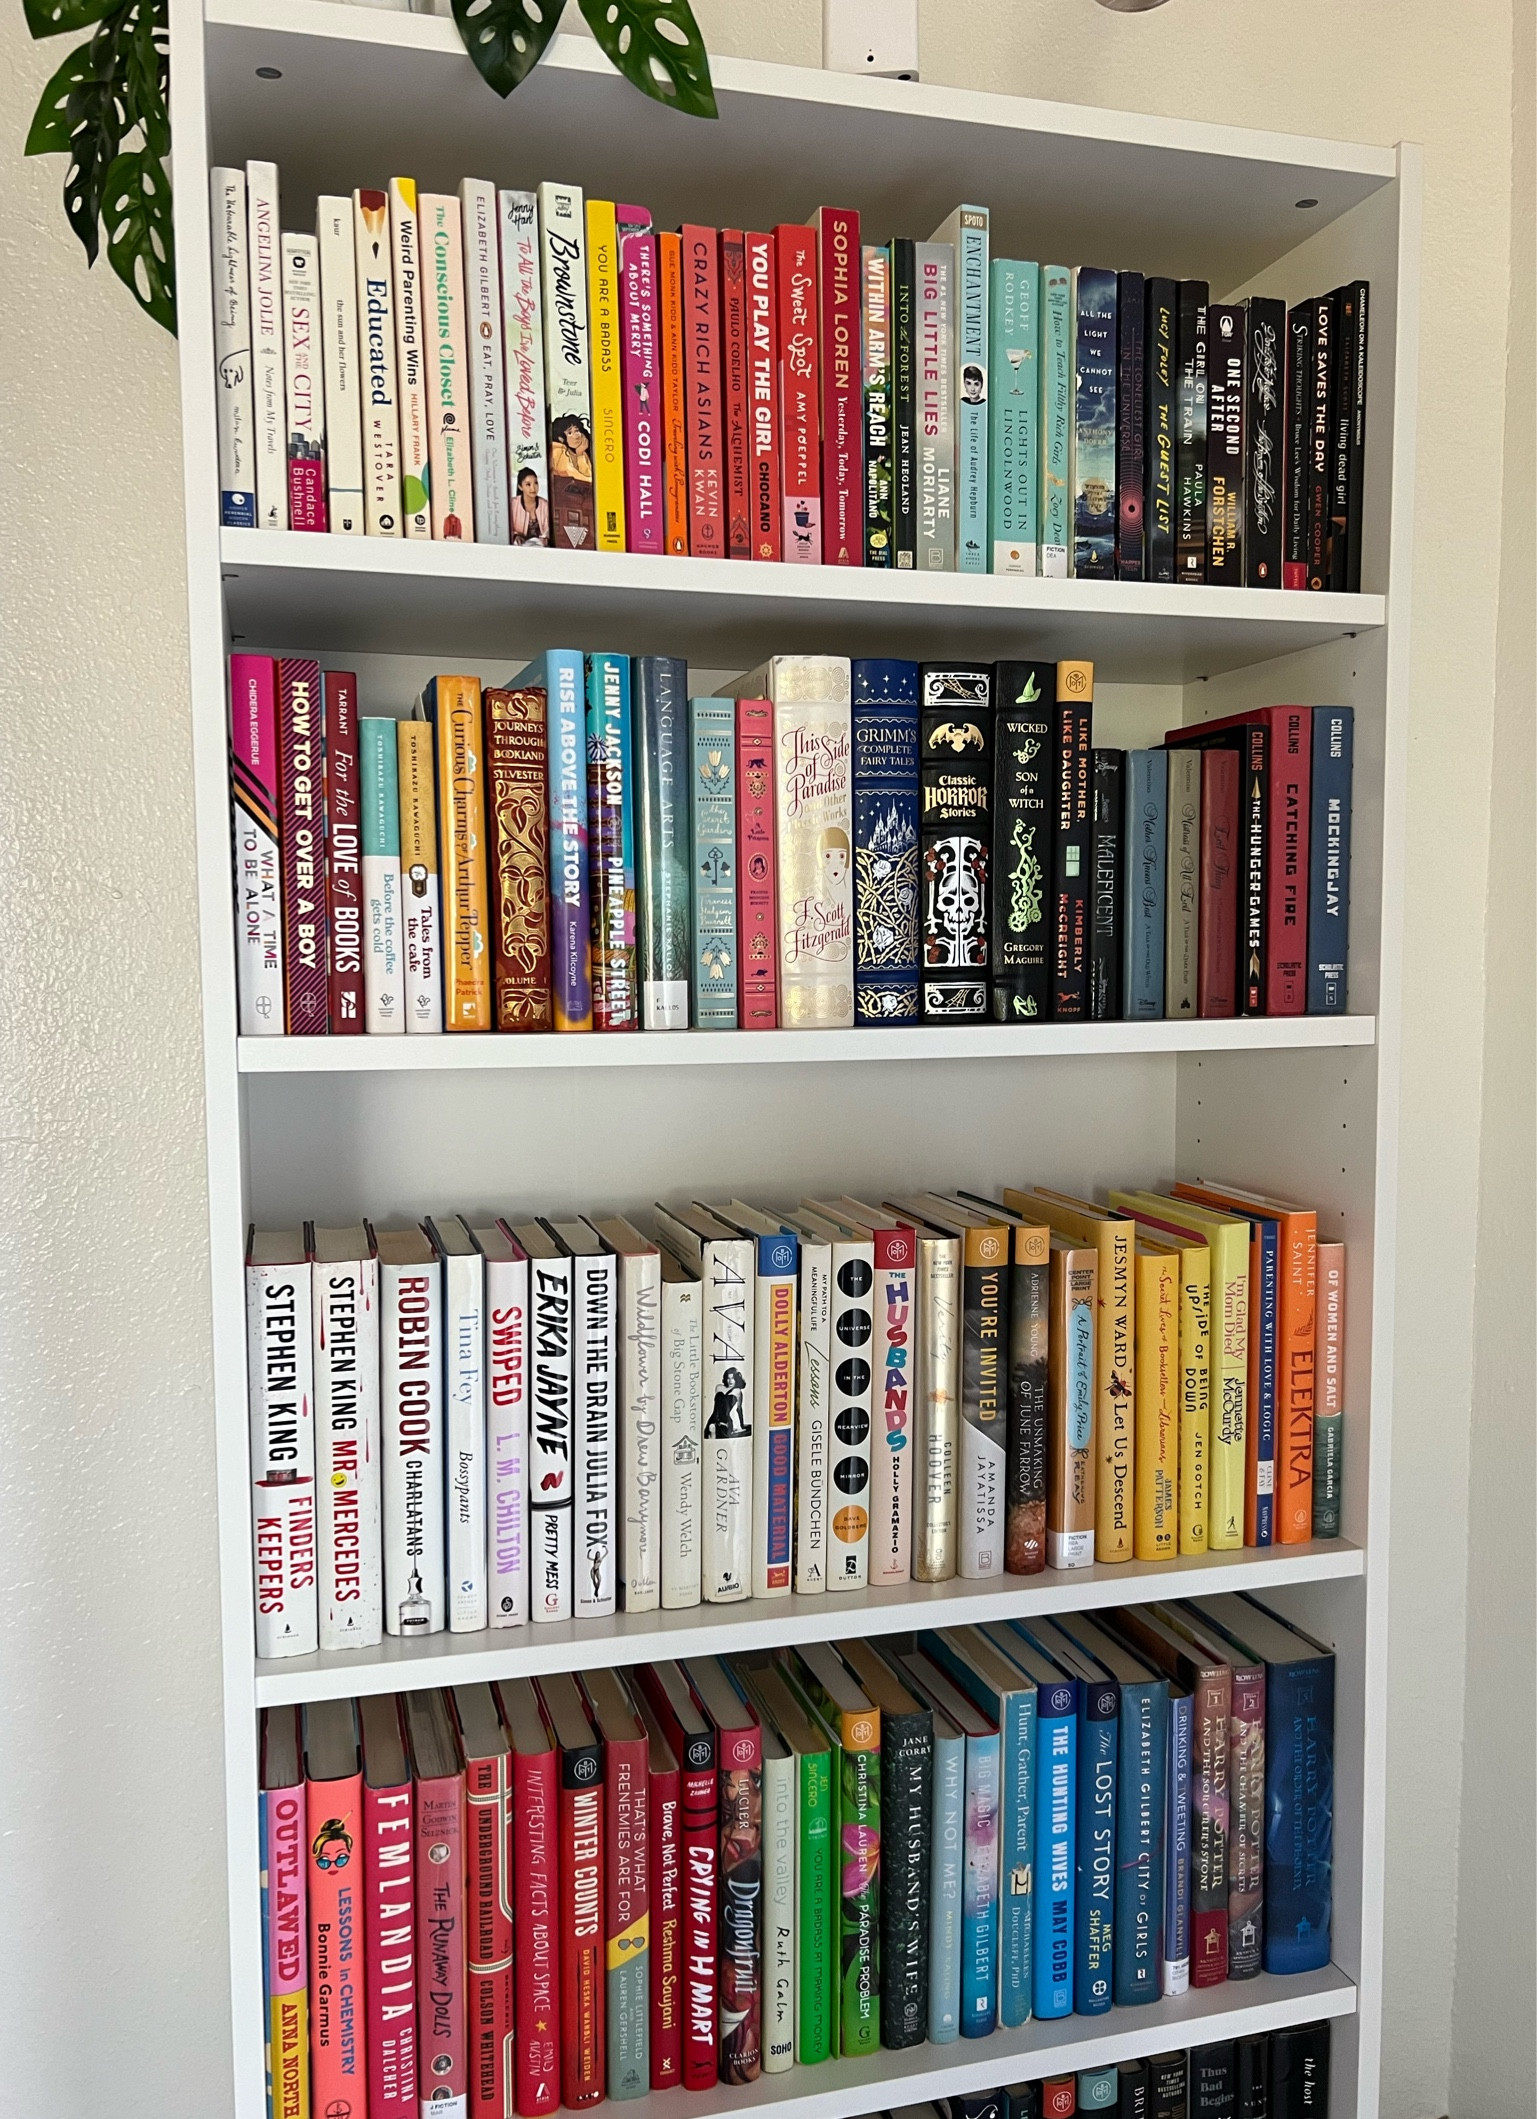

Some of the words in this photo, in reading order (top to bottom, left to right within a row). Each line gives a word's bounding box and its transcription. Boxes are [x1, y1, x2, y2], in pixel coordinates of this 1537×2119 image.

[257, 199, 272, 282] ANGELINA
[400, 221, 413, 264] Weird
[436, 206, 446, 227] The
[476, 196, 488, 262] ELIZABETH
[435, 232, 452, 338] Conscious
[693, 242, 708, 315] CRAZY
[833, 221, 848, 305] SOPHIA
[259, 287, 273, 335] JOLIE
[336, 300, 344, 311] the
[401, 270, 415, 344] Parenting
[480, 267, 491, 317] GILBERT
[547, 229, 585, 365] Brownstone
[966, 235, 981, 356] ENCHANTMENT
[1005, 272, 1015, 336] RODKEY
[1020, 280, 1029, 331] GEOFF
[337, 330, 346, 344] and
[338, 347, 346, 359] her
[367, 278, 391, 406] Educated
[696, 323, 710, 374] RICH
[835, 314, 849, 388] LOREN
[339, 362, 348, 391] flowers
[407, 349, 419, 385] Wins
[439, 344, 455, 408] Closet
[410, 394, 419, 431] HILLARY
[603, 408, 615, 463] SINCERO
[698, 382, 712, 460] ASIANS
[1159, 404, 1168, 429] THE
[373, 421, 384, 502] WESTOVER
[385, 442, 394, 481] TARA
[413, 436, 421, 466] FRANK
[638, 421, 651, 465] CODI
[1157, 434, 1170, 495] GUEST
[293, 468, 305, 525] Bushnell
[304, 469, 317, 525] Candace
[639, 475, 653, 519] HALL
[759, 462, 770, 532] CHOCANO
[922, 447, 936, 539] MORIARTY
[937, 468, 950, 518] LIANE
[1182, 477, 1192, 540] HAWKINS
[1194, 464, 1203, 506] PAULA
[1157, 499, 1170, 534] LIST
[1212, 477, 1224, 566] FORSTCHEN
[248, 679, 258, 720] CHIDERA
[604, 662, 621, 718] JENNY
[250, 721, 259, 765] EGGERUE
[493, 721, 544, 734] JOURNEYS
[494, 737, 544, 745] THROUGH
[659, 673, 674, 786] LANGUAGE
[857, 744, 913, 755] COMPLETE
[1007, 723, 1048, 734] WICKED
[1251, 732, 1264, 771] COLLINS
[1287, 715, 1300, 754] COLLINS
[1330, 719, 1343, 757] COLLINS
[494, 749, 544, 761] BOOKLAND
[495, 769, 544, 780] SILVESTER
[605, 724, 623, 805] JACKSON
[861, 757, 886, 766] FAIRY
[890, 757, 914, 766] TALES
[938, 775, 977, 786] Classic
[924, 786, 988, 810] HORROR
[940, 807, 977, 818] Stories
[1008, 798, 1044, 809] WITCH
[1252, 800, 1261, 818] THE
[662, 800, 675, 849] ARTS
[1285, 784, 1299, 876] CATCHING
[1249, 823, 1263, 891] HUNGER
[1326, 798, 1340, 917] MOCKINGJAY
[1096, 835, 1115, 937] MALEFICENT
[1284, 885, 1296, 926] FIRE
[407, 918, 418, 939] the
[420, 906, 432, 943] Tales
[569, 921, 578, 949] Karena
[1058, 894, 1068, 978] McCREIGHT
[1074, 899, 1083, 973] KIMBERLY
[1249, 896, 1262, 948] GAMES
[408, 944, 419, 972] cafe
[422, 948, 433, 979] from
[569, 951, 579, 986] Kilcoyne
[1030, 1273, 1039, 1321] ADRIENNE
[1113, 1235, 1128, 1308] JESMYN
[398, 1277, 430, 1370] ROBIN
[535, 1269, 569, 1358] ERIKA
[774, 1288, 790, 1338] DOLLY
[980, 1273, 998, 1339] YOU'RE
[265, 1284, 296, 1391] STEPHEN
[492, 1306, 522, 1407] SWIPED
[1030, 1323, 1039, 1357] YOUNG
[1114, 1315, 1127, 1368] WARD
[774, 1342, 791, 1422] ALDERTON
[979, 1347, 997, 1421] INVITED
[267, 1403, 298, 1461] KING
[398, 1380, 430, 1457] COOK
[535, 1364, 569, 1462] JAYNE
[1218, 1378, 1234, 1445] McCurdy
[1233, 1378, 1245, 1442] Jennette
[1289, 1351, 1313, 1490] ELEKTRA
[811, 1420, 822, 1466] GISELE
[1327, 1427, 1335, 1467] GABRIELA
[456, 1451, 473, 1524] Bossypants
[586, 1449, 608, 1503] JULIA
[677, 1472, 692, 1520] Wendy
[716, 1448, 728, 1533] GARDNER
[729, 1474, 740, 1505] AVA
[976, 1455, 986, 1534] JAYATISSA
[987, 1461, 996, 1528] AMANDA
[1154, 1469, 1164, 1528] PATTERSON
[1194, 1464, 1202, 1509] GOTCH
[1326, 1469, 1334, 1499] GARCIA
[586, 1510, 608, 1548] FOX
[810, 1470, 824, 1549] BÜNDCHEN
[257, 1517, 284, 1614] KEEPERS
[289, 1497, 314, 1589] FINDERS
[680, 1523, 692, 1558] Welch
[1141, 1698, 1151, 1775] ELIZABETH
[738, 1778, 749, 1829] LUCIER
[808, 1762, 818, 1807] SINCERO
[909, 1766, 922, 1795] MY
[573, 1792, 599, 1860] WINTER
[1140, 1783, 1150, 1845] GILBERT
[275, 1799, 300, 1982] OUTLAWED
[907, 1807, 922, 1930] HUSBAND'S
[376, 1794, 413, 2021] FEMLANDIA
[574, 1868, 598, 1937] COUNTS
[1053, 1900, 1067, 1934] MAY
[317, 1923, 331, 1979] Bonnie
[662, 1919, 676, 1973] Reshma
[776, 1926, 790, 1968] Ruth
[859, 1904, 870, 1962] PARADISE
[1089, 1909, 1100, 1970] SHAFFER
[1102, 1924, 1111, 1952] MEG
[904, 1940, 920, 1996] WIFE
[1053, 1940, 1067, 1982] COBB
[318, 1984, 332, 2047] Garmus
[480, 1980, 493, 2025] COLSON
[658, 1976, 676, 2029] Saujani
[777, 1979, 790, 2023] Galm
[860, 1966, 870, 2018] PROBLEM
[281, 2003, 298, 2053] ANNA
[283, 2057, 300, 2119] NORTH
[480, 2031, 494, 2101] WHITEHEAD
[1200, 2065, 1227, 2078] Thus
[1200, 2082, 1222, 2093] Bad
[1304, 2058, 1314, 2080] the
[1200, 2093, 1235, 2107] Begins
[1303, 2083, 1312, 2106] host
